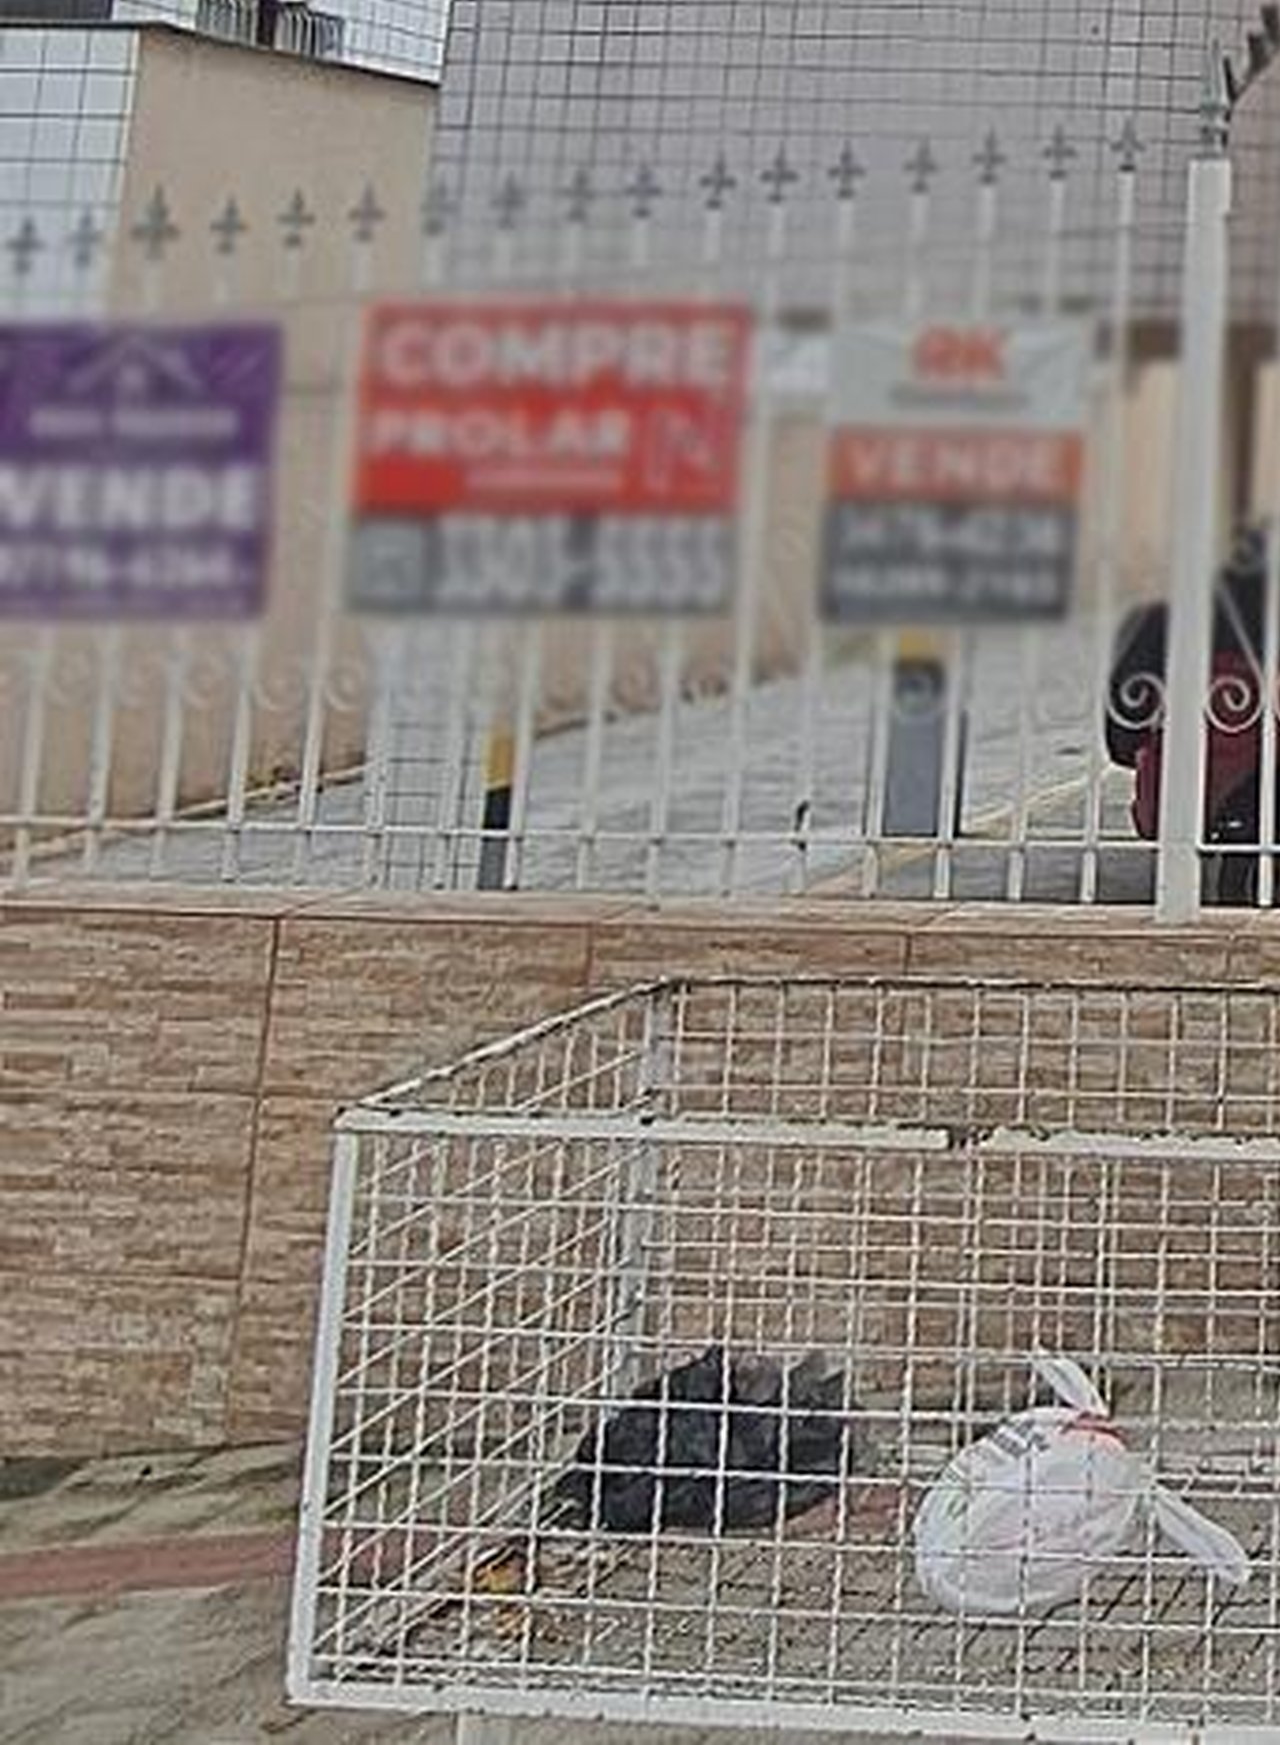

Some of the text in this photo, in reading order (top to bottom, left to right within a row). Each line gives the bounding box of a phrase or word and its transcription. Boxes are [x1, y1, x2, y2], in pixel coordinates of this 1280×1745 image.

[380, 320, 732, 388] COMPRE
[851, 439, 1062, 488] VENDE
[0, 467, 256, 527] VENDE
